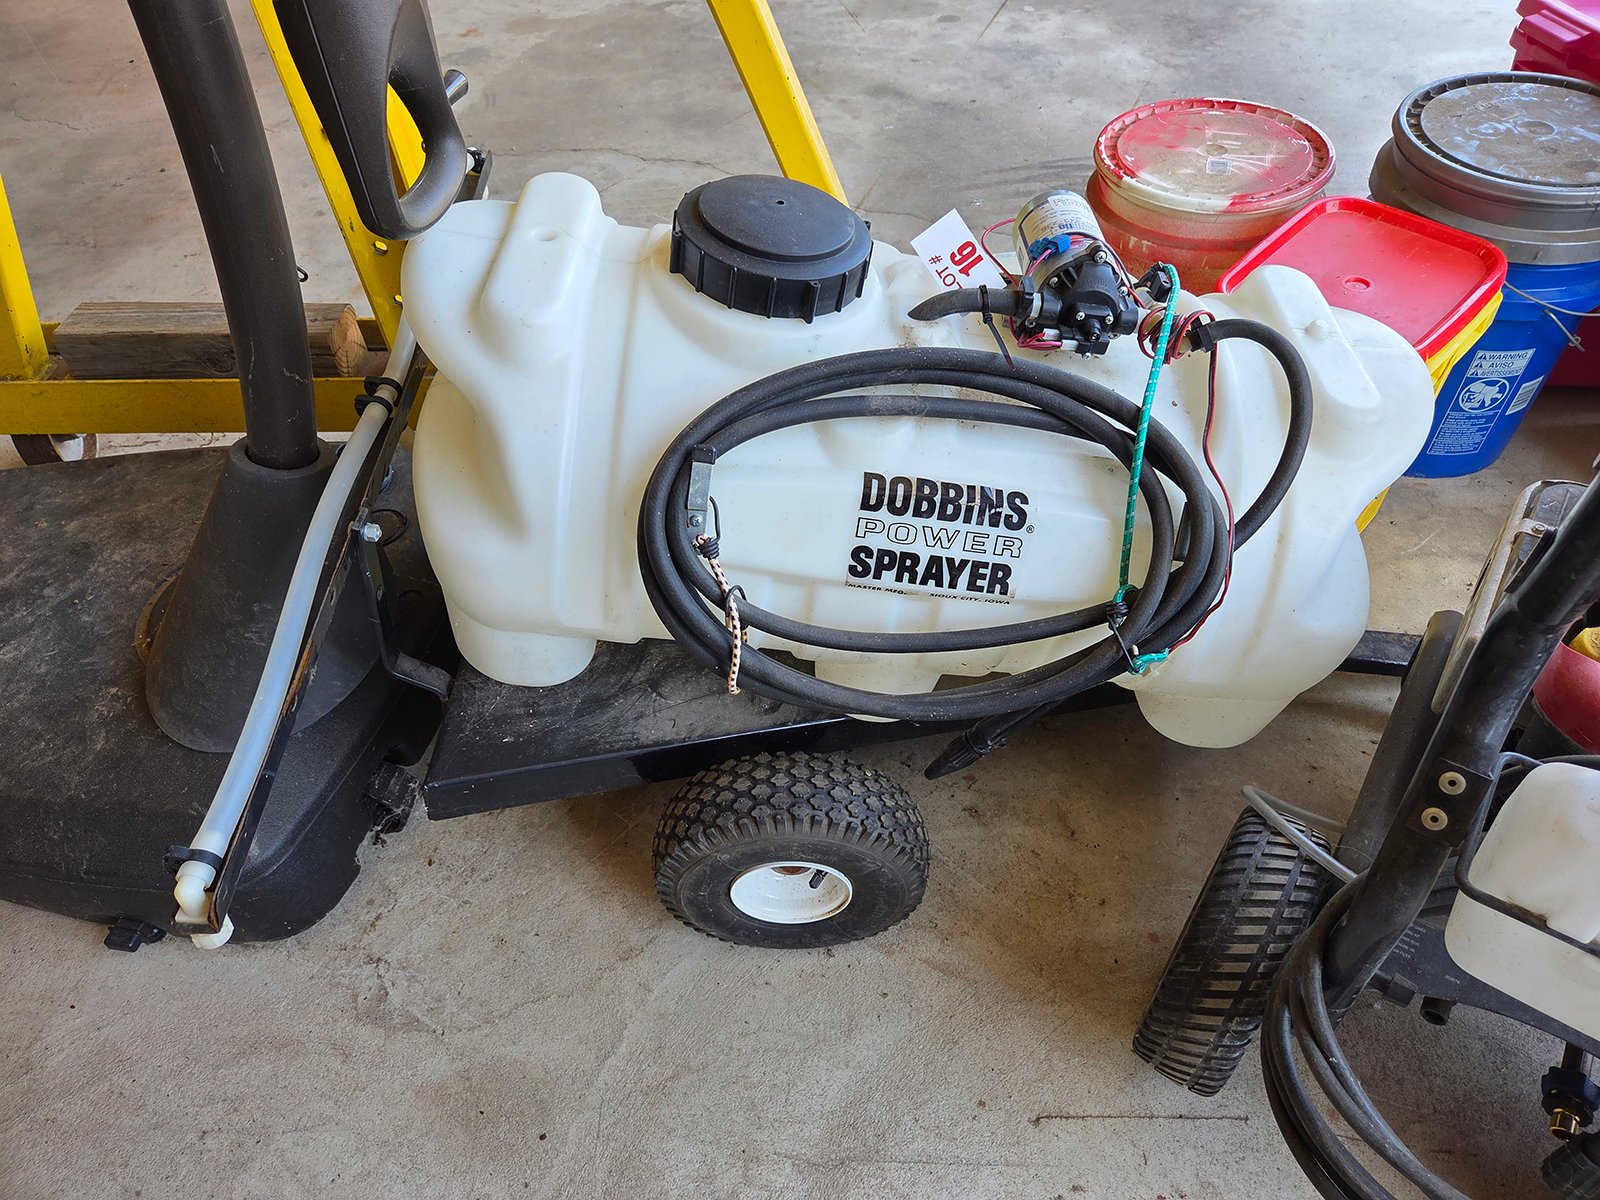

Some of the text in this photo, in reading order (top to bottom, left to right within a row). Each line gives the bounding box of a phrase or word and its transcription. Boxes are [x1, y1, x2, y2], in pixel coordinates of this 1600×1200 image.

[950, 241, 984, 277] 16
[1488, 352, 1529, 360] WARNING
[1488, 361, 1515, 369] AVISO
[855, 516, 1023, 559] POWER
[848, 545, 1013, 596] SPRAYER
[847, 583, 882, 593] MASTER
[930, 592, 958, 600] SIOUX
